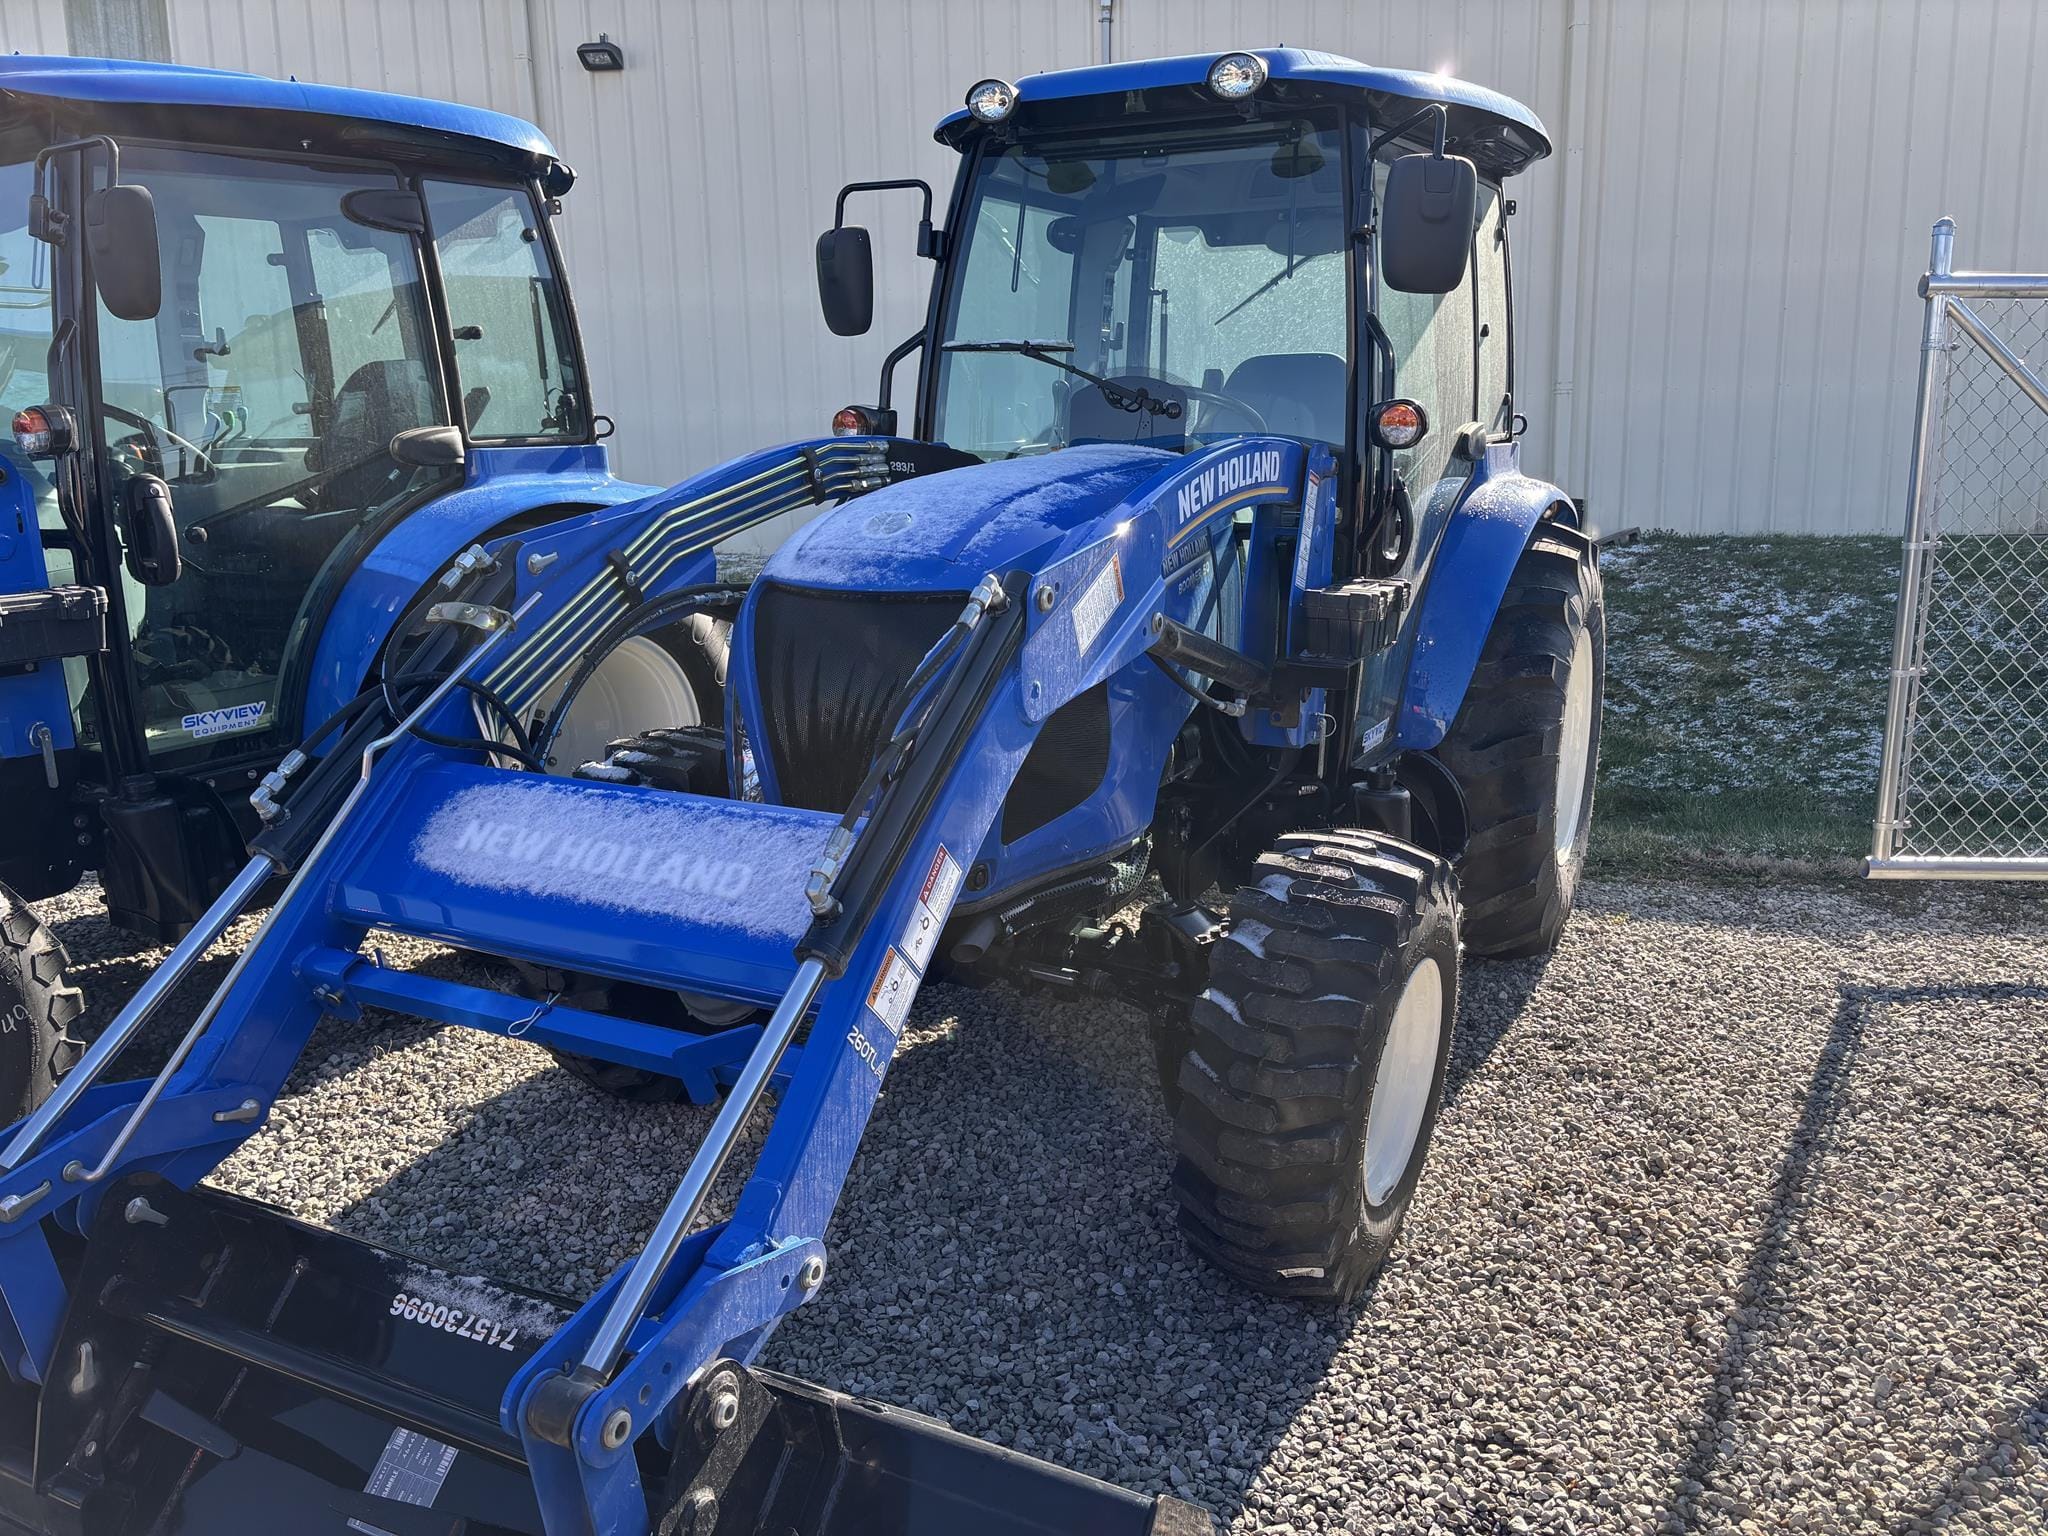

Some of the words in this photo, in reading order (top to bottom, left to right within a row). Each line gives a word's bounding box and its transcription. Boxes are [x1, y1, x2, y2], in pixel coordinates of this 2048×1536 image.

[1177, 468, 1215, 524] NEW
[1218, 451, 1280, 496] HOLLAND
[1162, 553, 1181, 576] NEW
[1180, 534, 1208, 566] HOLLAND
[183, 704, 264, 728] SKYVIEW
[195, 719, 256, 736] EQUIPMENT
[455, 818, 553, 863] NEW
[551, 835, 754, 899] HOLLAND
[928, 851, 945, 889] DANGER
[873, 955, 893, 992] WARNING
[847, 1025, 886, 1081] 260TLA
[389, 1293, 519, 1352] 715730096
